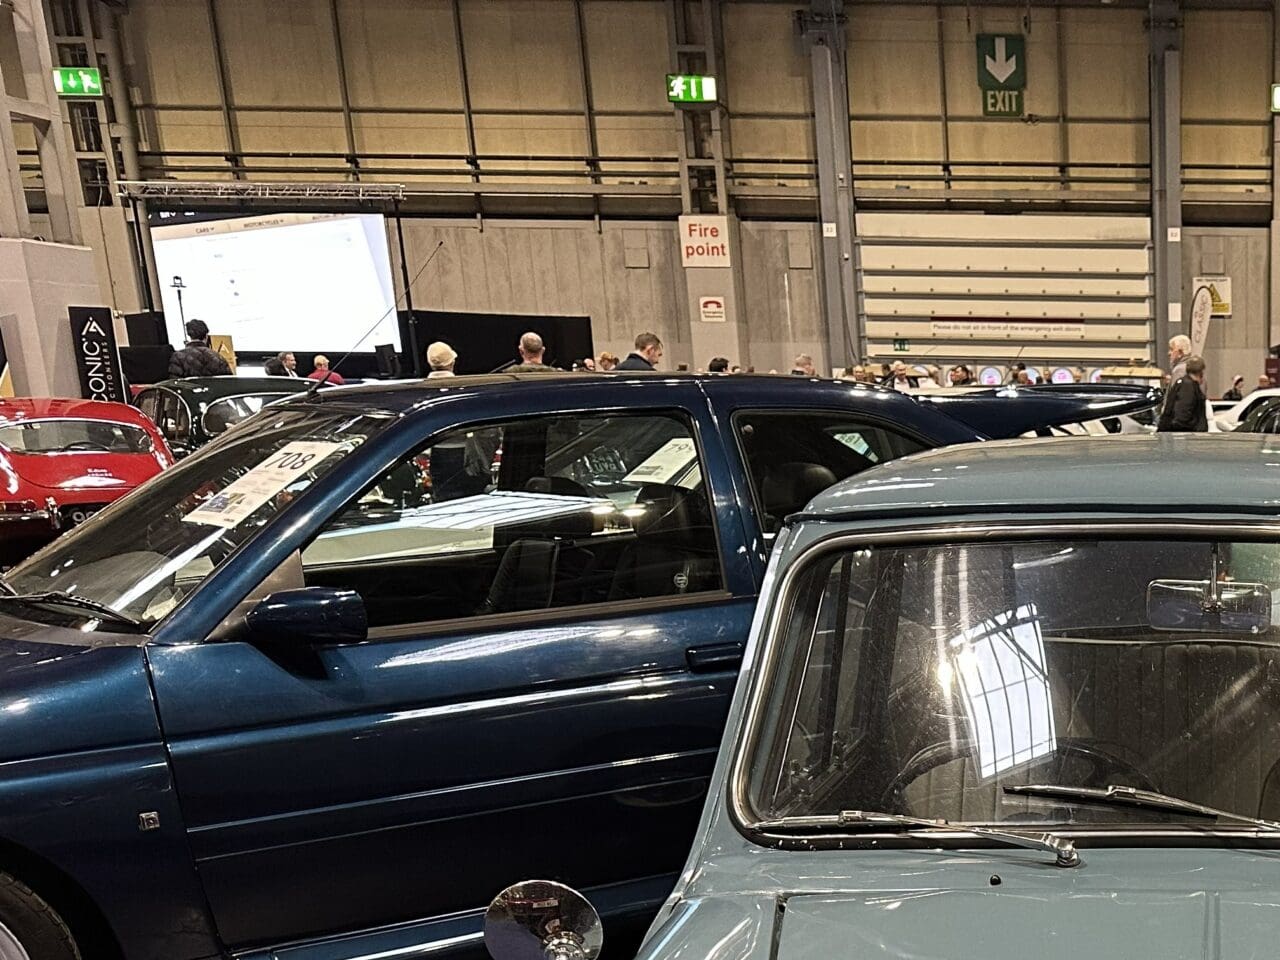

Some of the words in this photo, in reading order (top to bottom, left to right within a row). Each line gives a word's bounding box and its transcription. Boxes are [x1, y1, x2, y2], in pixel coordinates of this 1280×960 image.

[986, 90, 1018, 112] EXIT
[687, 223, 720, 237] Fire
[685, 243, 727, 258] point
[83, 341, 108, 401] CONIC
[101, 341, 116, 400] CTIONEERS
[264, 452, 316, 470] 708
